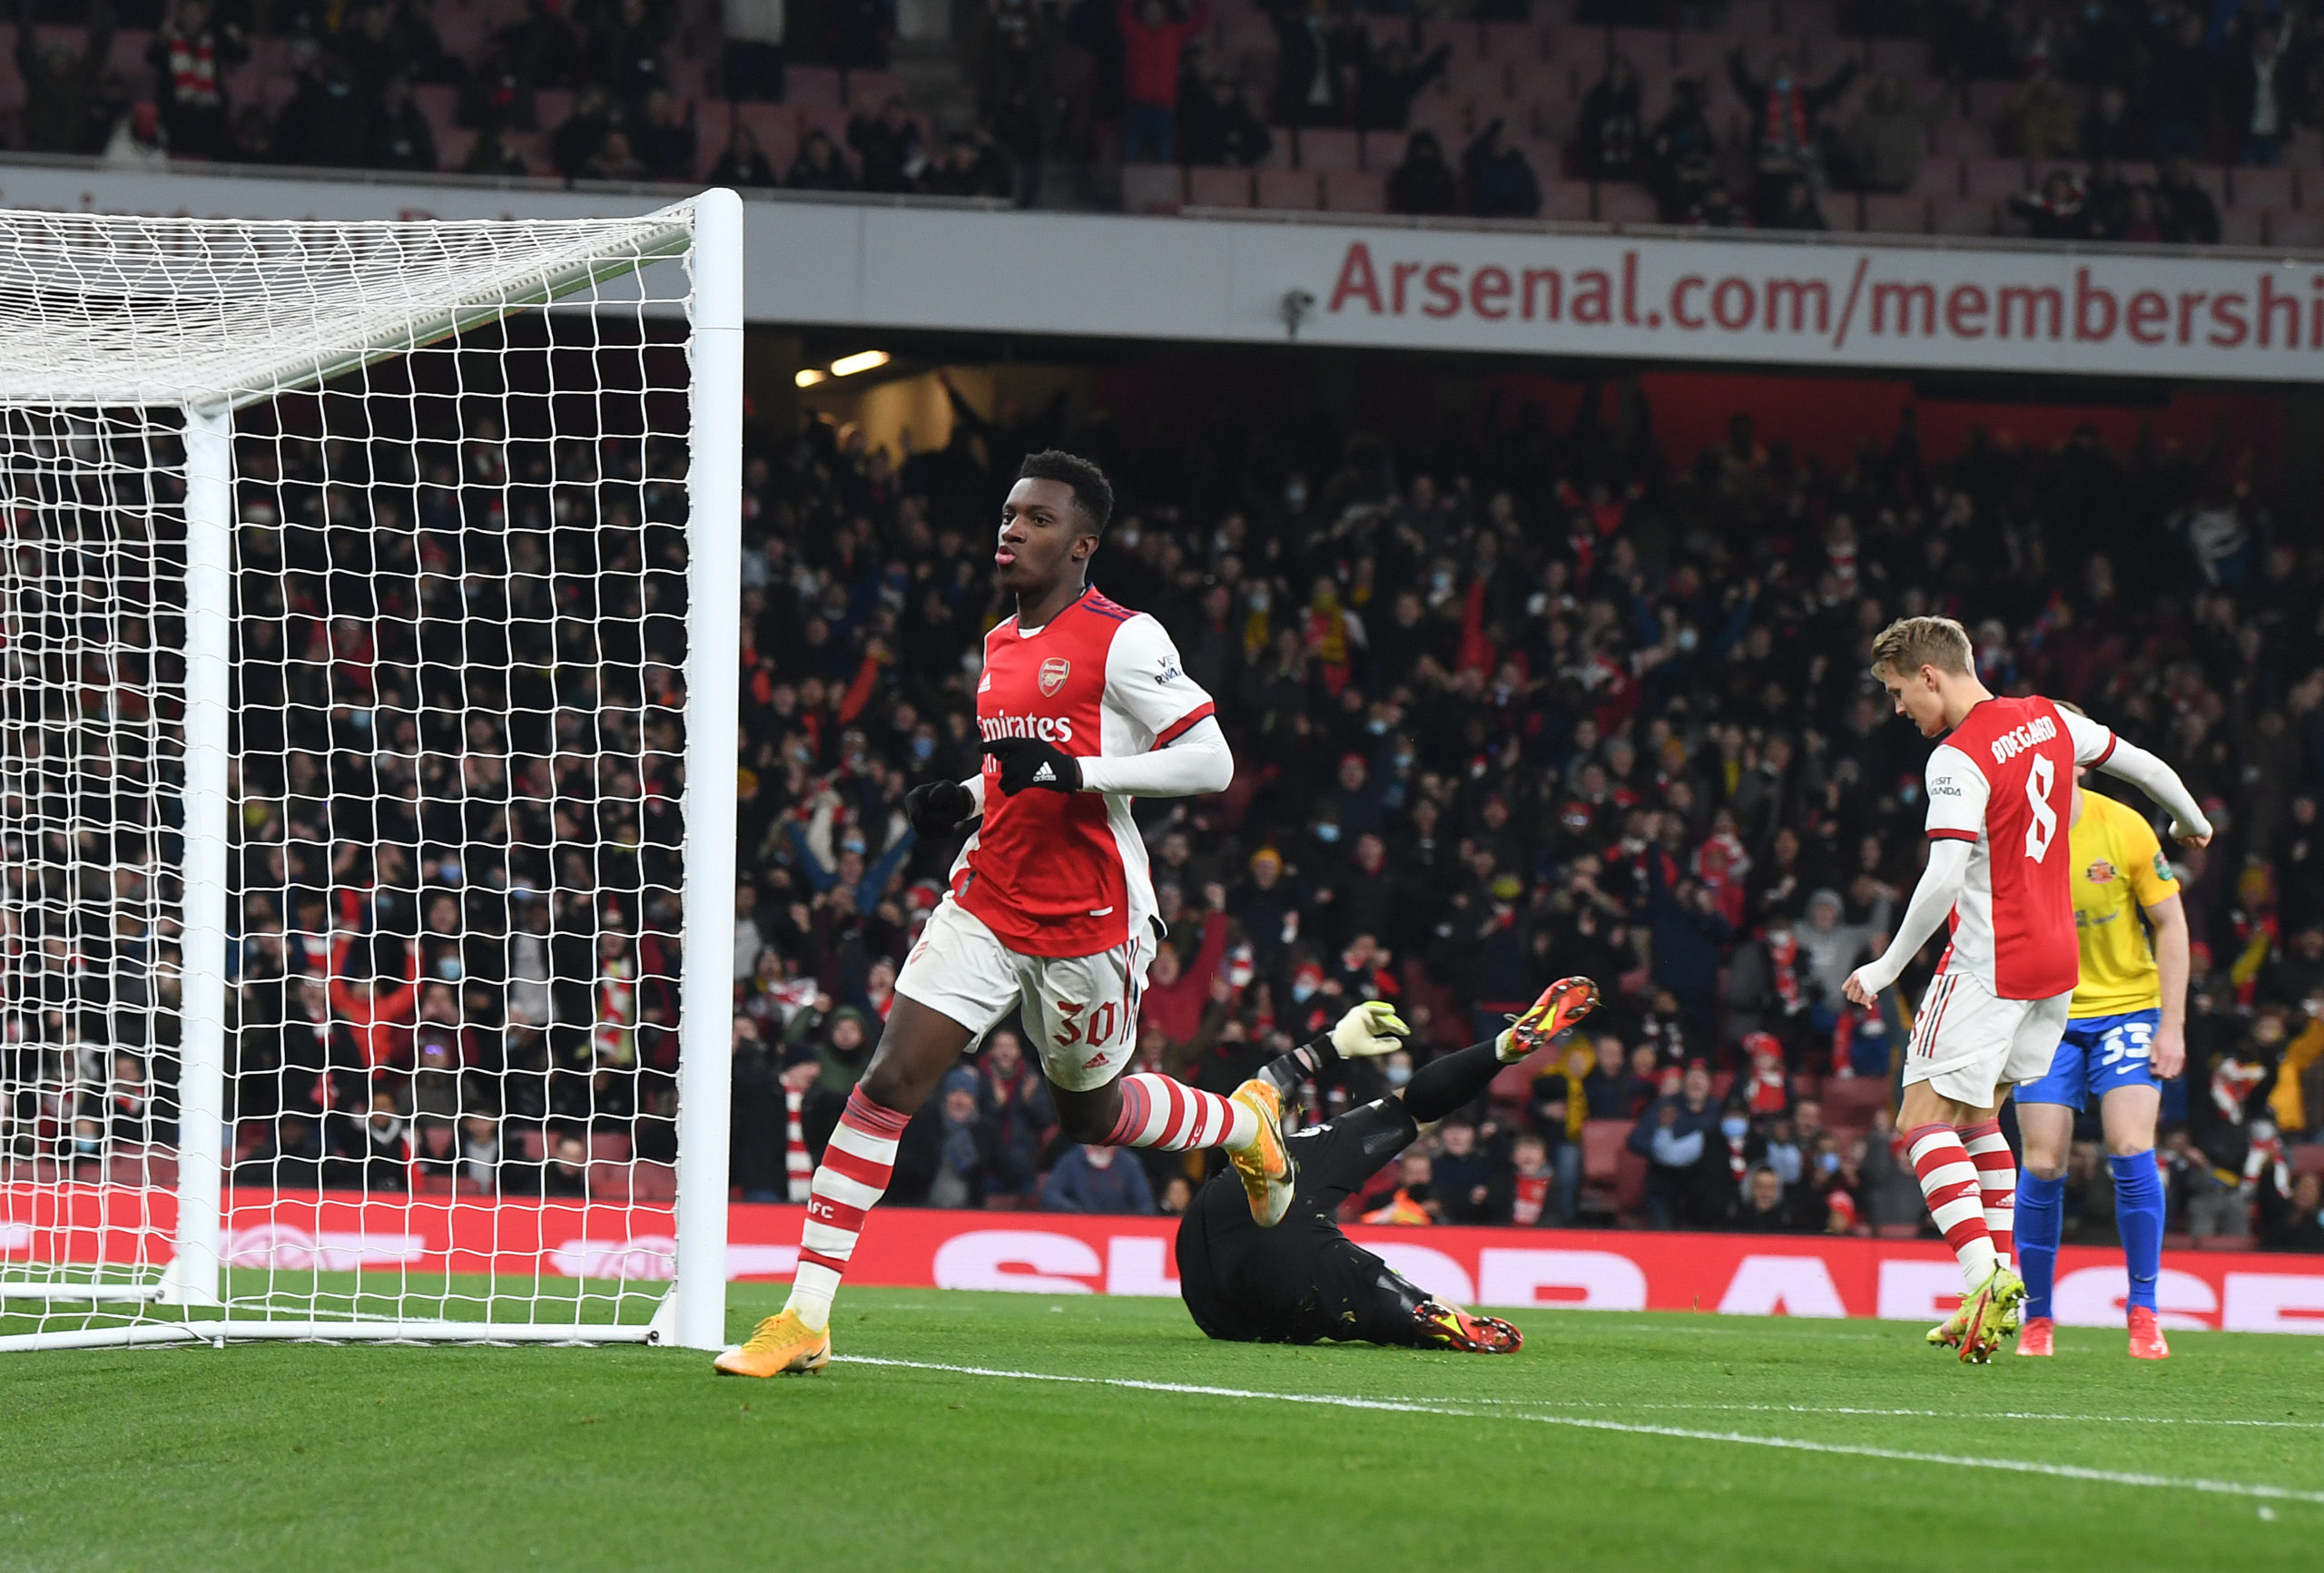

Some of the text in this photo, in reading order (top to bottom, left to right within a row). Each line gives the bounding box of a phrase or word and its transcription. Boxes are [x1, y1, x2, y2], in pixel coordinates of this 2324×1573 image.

[2025, 752, 2057, 864] 8
[1053, 1000, 1117, 1047] 30
[2100, 1022, 2153, 1066] 33
